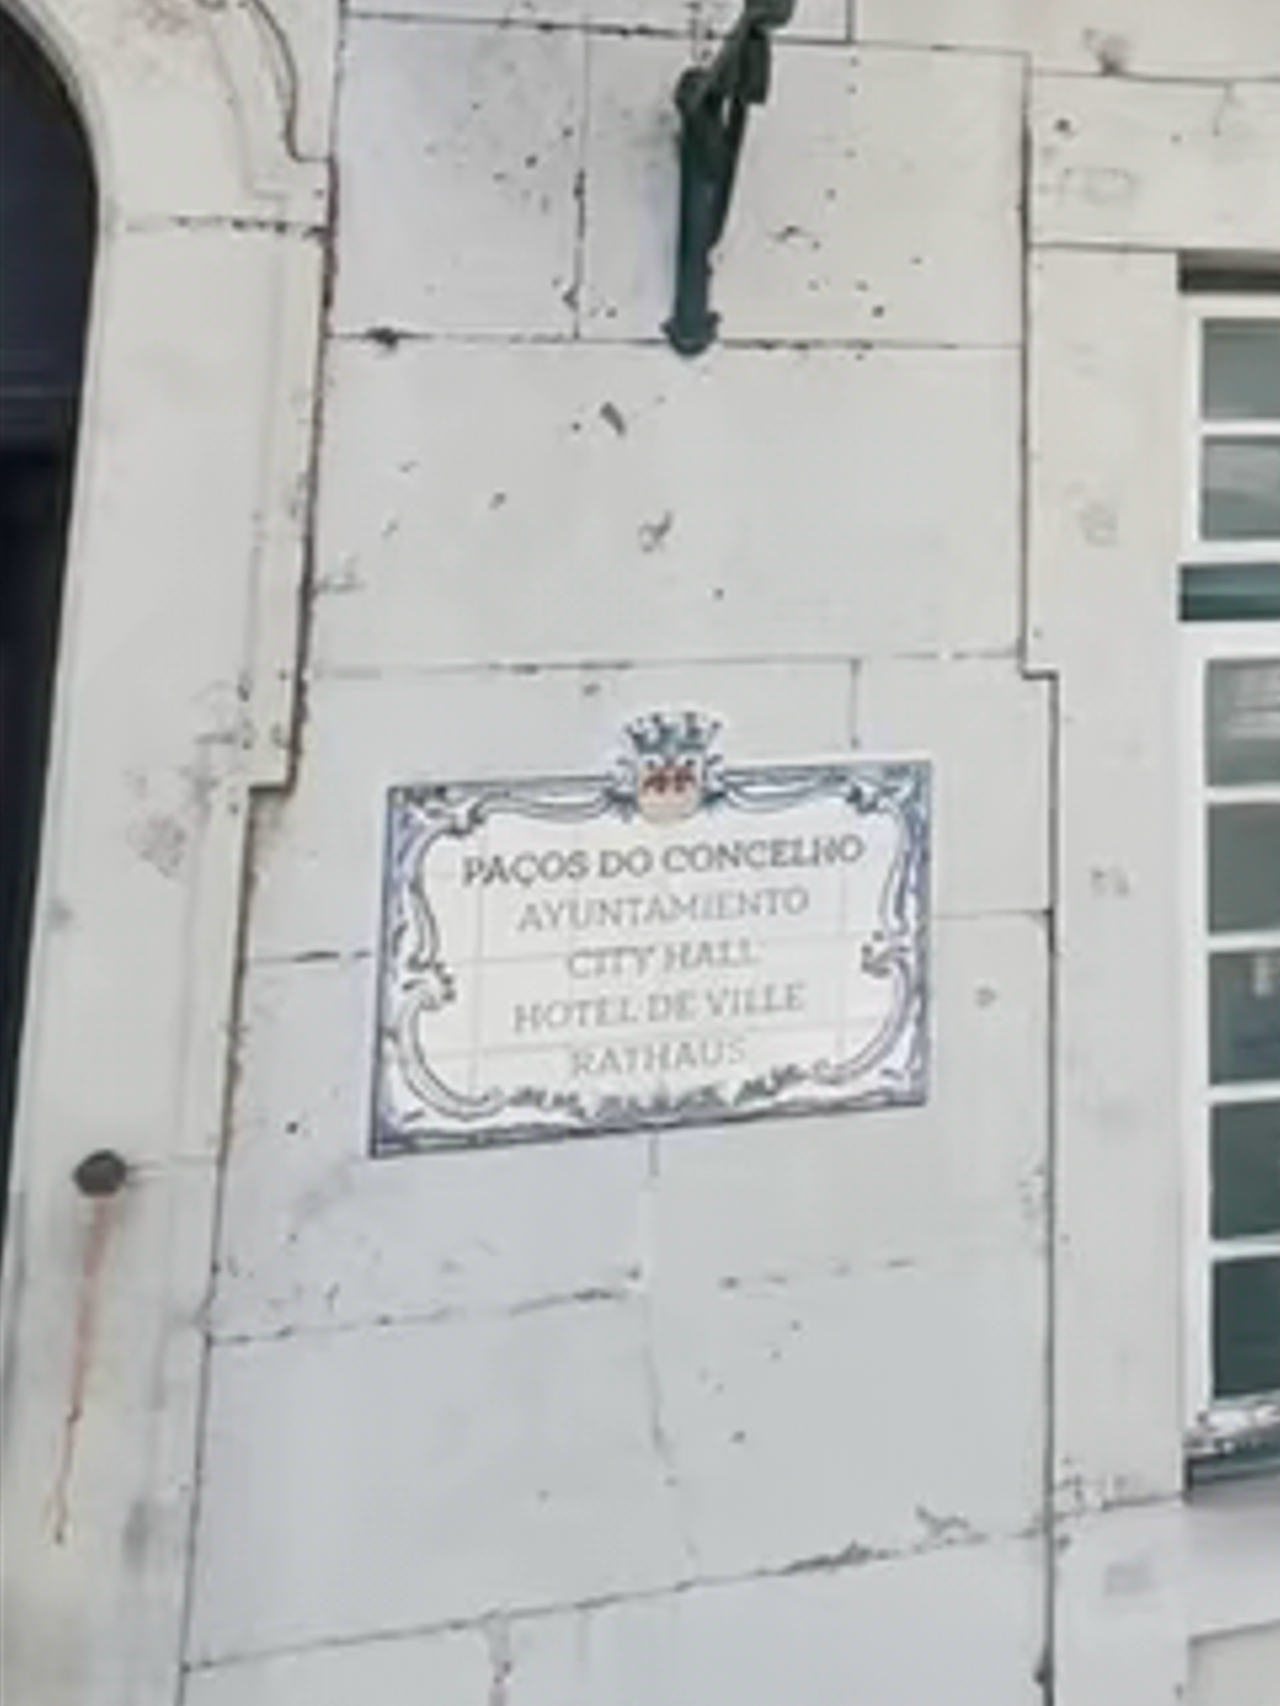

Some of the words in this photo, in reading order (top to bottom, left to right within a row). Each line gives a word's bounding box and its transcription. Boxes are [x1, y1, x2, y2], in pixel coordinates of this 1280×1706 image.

[463, 849, 590, 888] PAÇOS
[599, 845, 653, 878] DO
[661, 834, 865, 873] CONCELHO
[516, 886, 810, 933] AYUNTAMIENTO
[566, 945, 655, 979] CITY
[662, 938, 763, 973] HALL
[512, 996, 638, 1032] HOTEL
[646, 989, 697, 1022] DE
[705, 984, 805, 1016] VILLE
[569, 1037, 746, 1077] RATHAUS
